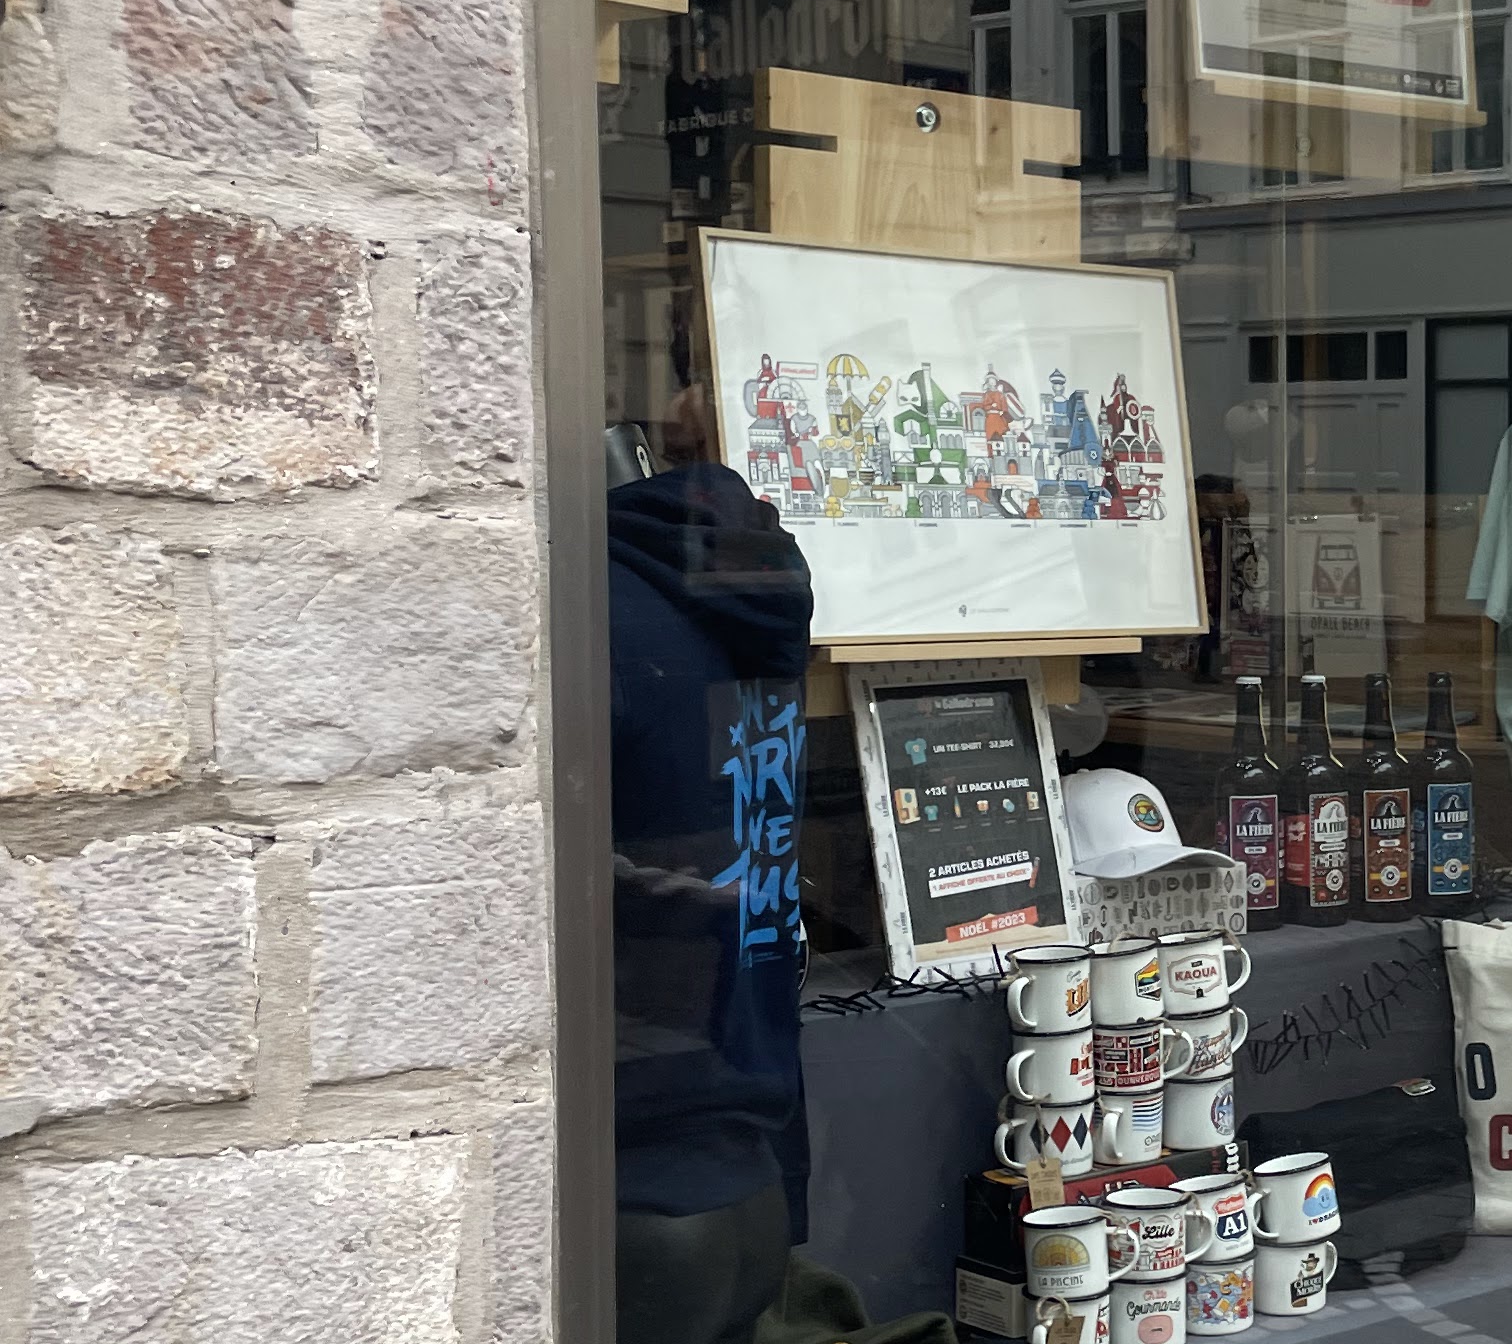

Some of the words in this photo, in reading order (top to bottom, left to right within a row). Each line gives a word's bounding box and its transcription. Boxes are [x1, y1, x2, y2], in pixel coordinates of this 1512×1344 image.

[957, 784, 968, 794] LE
[969, 782, 993, 792] PACK
[994, 780, 1005, 790] LA
[1370, 818, 1382, 830] LA
[1434, 811, 1445, 823] LA
[1236, 824, 1248, 836] LA
[1316, 822, 1328, 834] LA
[928, 868, 936, 878] 2
[938, 859, 985, 876] ARTICLES
[986, 850, 1030, 867] ACHETÉS
[991, 913, 1026, 930] #2023
[1175, 965, 1217, 982] KAOUA
[1141, 1224, 1175, 1240] Lille
[1222, 1213, 1248, 1236] A1
